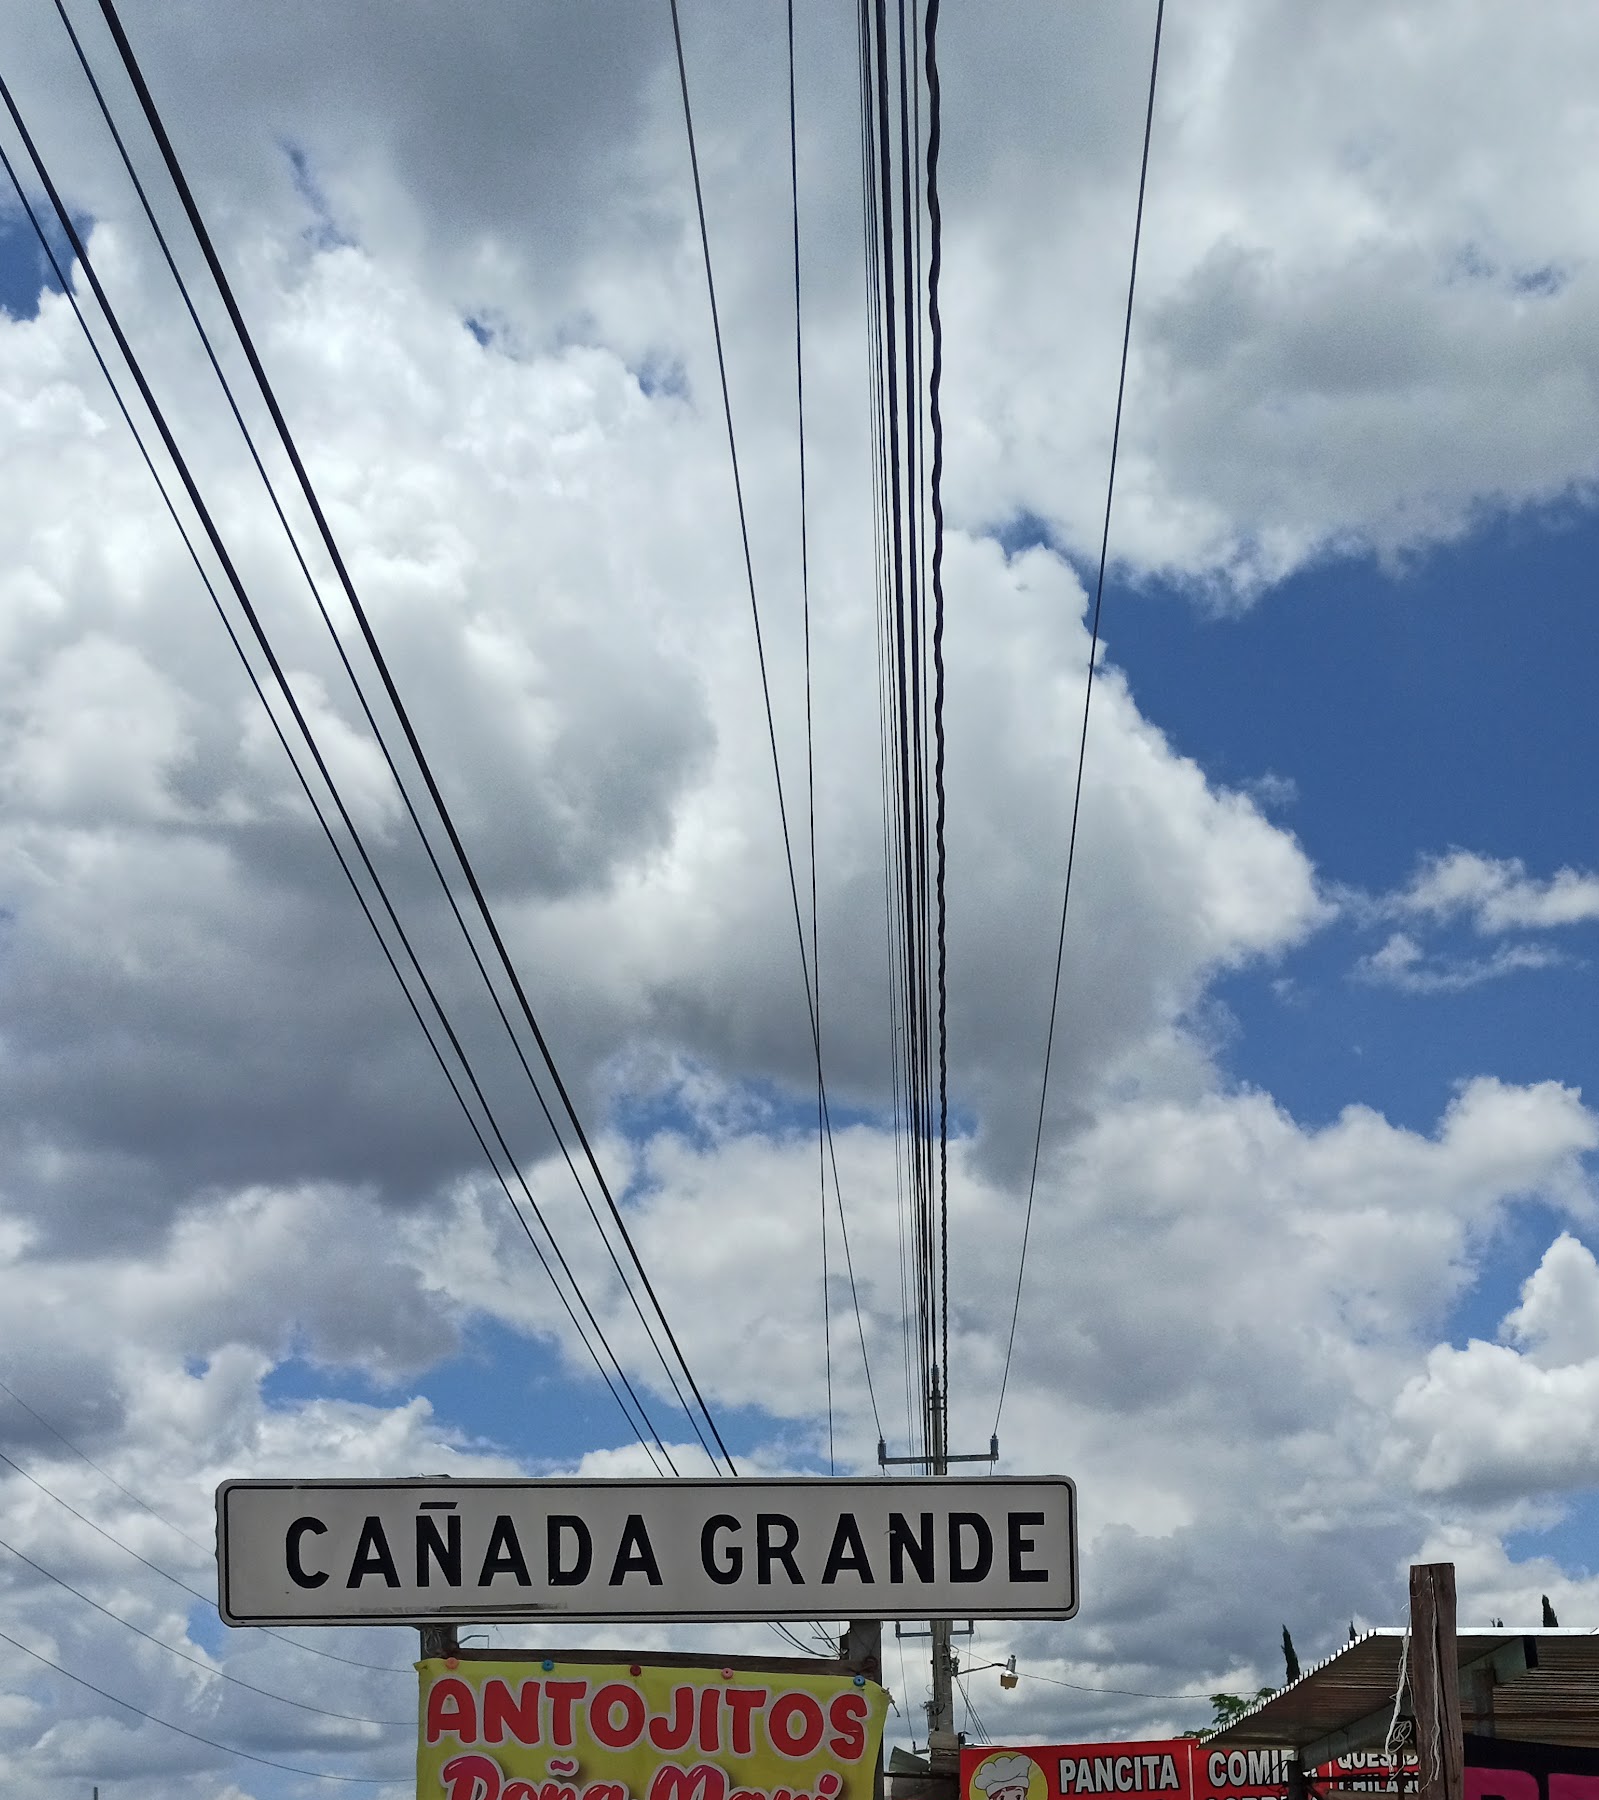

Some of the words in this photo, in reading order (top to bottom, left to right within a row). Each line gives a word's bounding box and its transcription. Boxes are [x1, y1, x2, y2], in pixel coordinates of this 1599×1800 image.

[285, 1501, 664, 1590] CAÑADA
[700, 1511, 1049, 1585] GRANDE
[426, 1677, 869, 1761] ANTOJITOS
[1059, 1754, 1179, 1794] PANCITA
